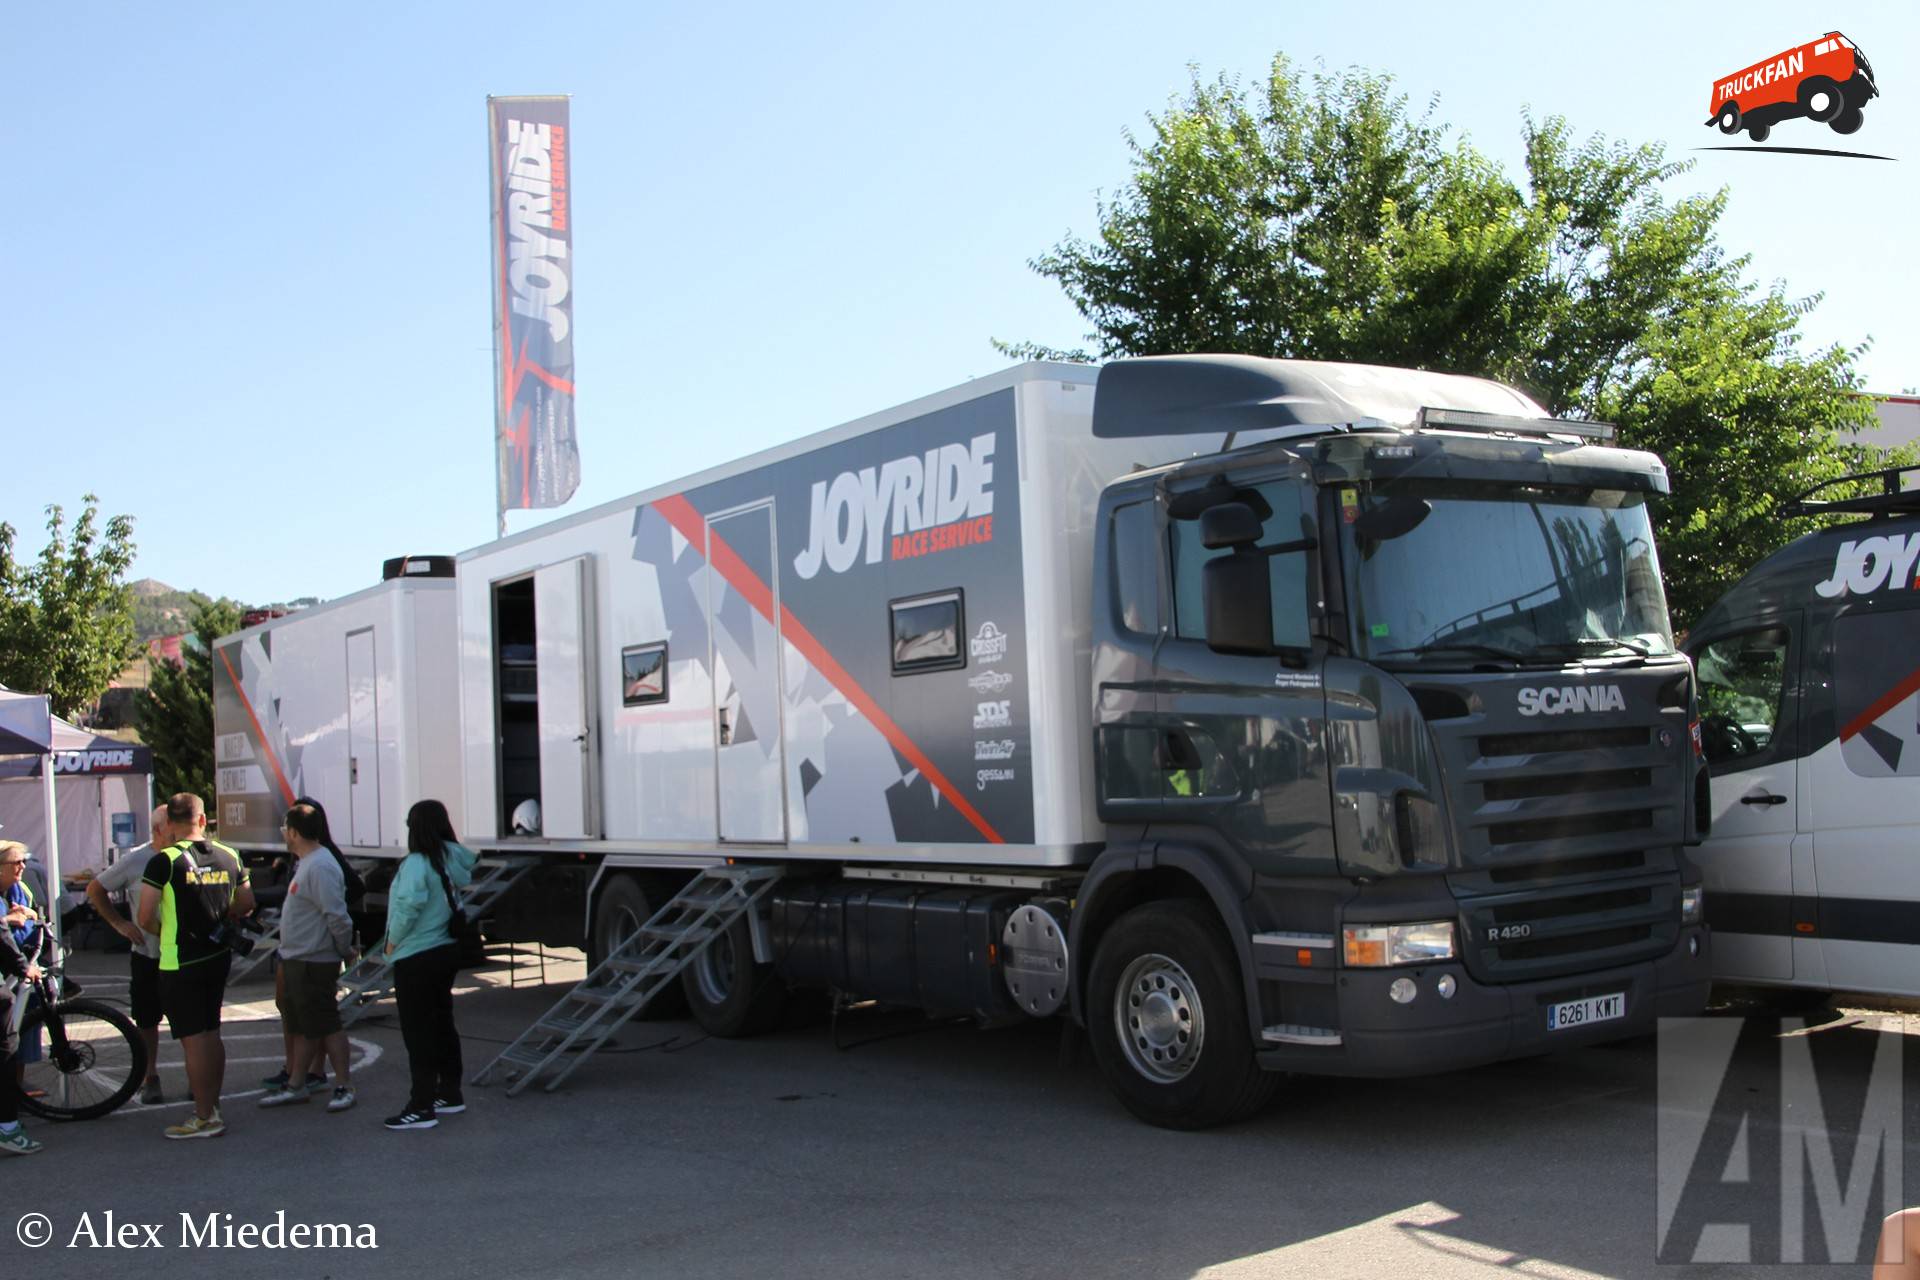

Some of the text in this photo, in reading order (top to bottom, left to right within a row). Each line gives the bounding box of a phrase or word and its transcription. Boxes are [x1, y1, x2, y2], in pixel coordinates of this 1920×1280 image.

[551, 124, 566, 231] RACE SERVICE
[507, 118, 569, 343] JOYRIDE
[793, 431, 996, 580] JOYRIDE
[891, 515, 993, 561] RACE SERVICE
[1814, 531, 1920, 598] JOY
[973, 700, 1011, 722] SDS
[1517, 684, 1626, 716] SCANIA
[54, 750, 134, 773] JOYRIDE
[1488, 924, 1531, 941] R 420
[1559, 997, 1619, 1025] 6261 KWT
